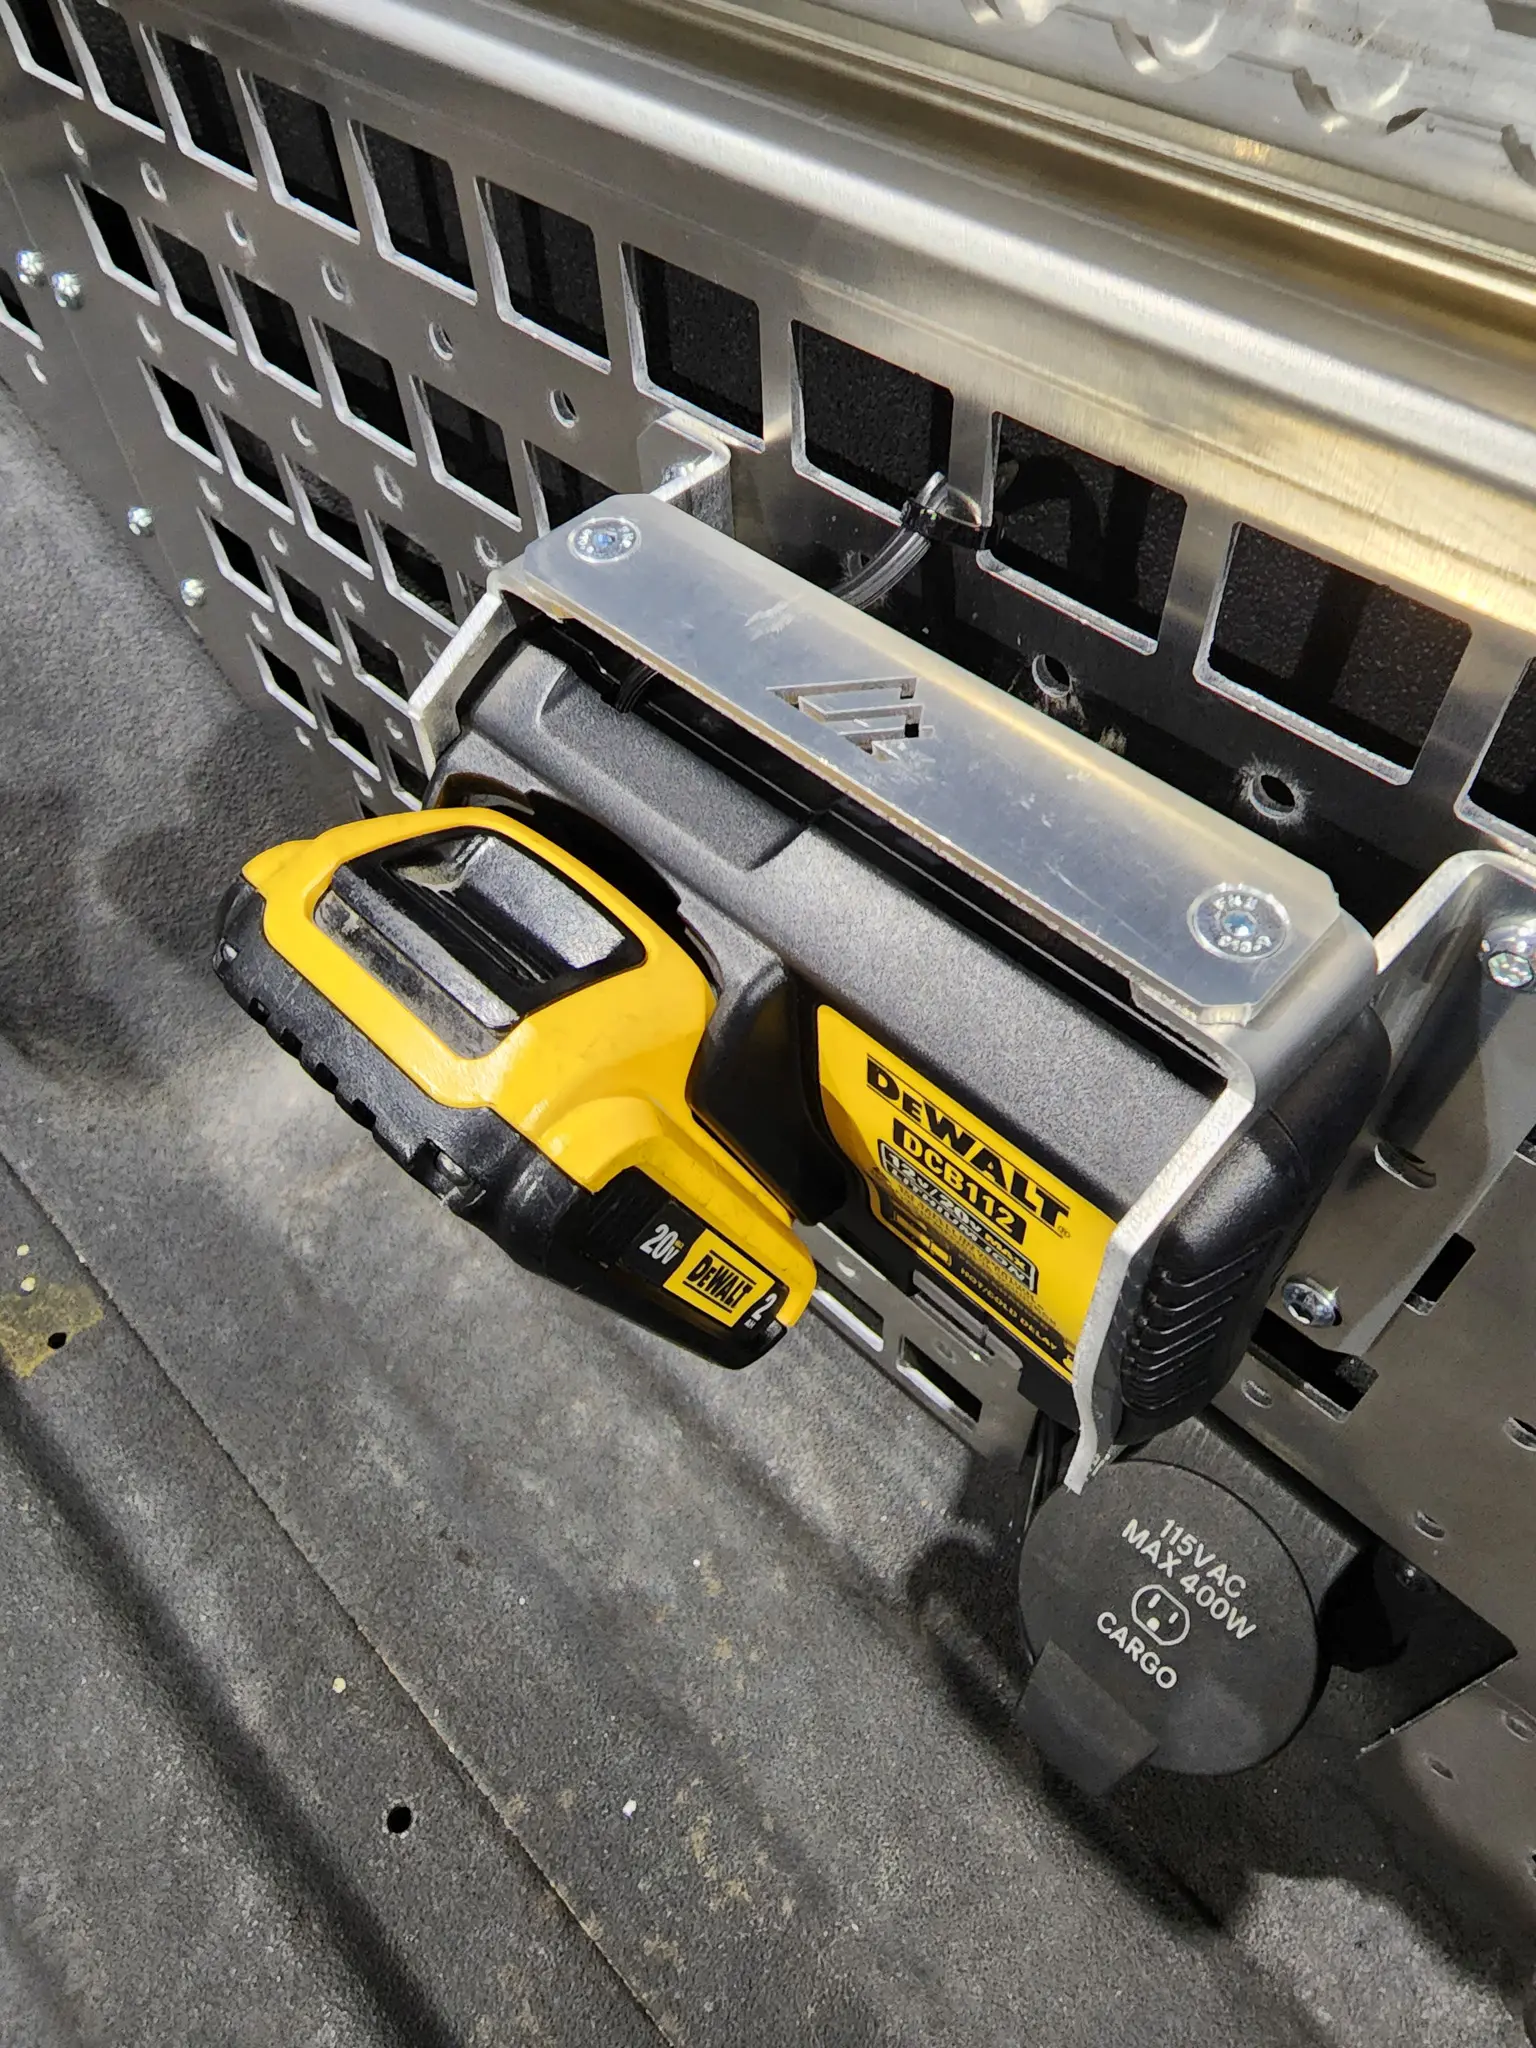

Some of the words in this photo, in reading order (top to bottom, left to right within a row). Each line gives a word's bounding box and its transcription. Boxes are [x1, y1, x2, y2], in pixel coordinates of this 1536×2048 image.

[902, 1125, 1017, 1234] DCB112
[891, 1167, 979, 1242] LITHIUM
[984, 1245, 1025, 1282] ION
[984, 1233, 1027, 1271] MAX
[750, 1292, 778, 1322] 2
[1019, 1316, 1058, 1351] DELAY
[1121, 1518, 1183, 1579] MAX
[1179, 1573, 1257, 1640] 400W
[1096, 1611, 1178, 1690] CARGO
